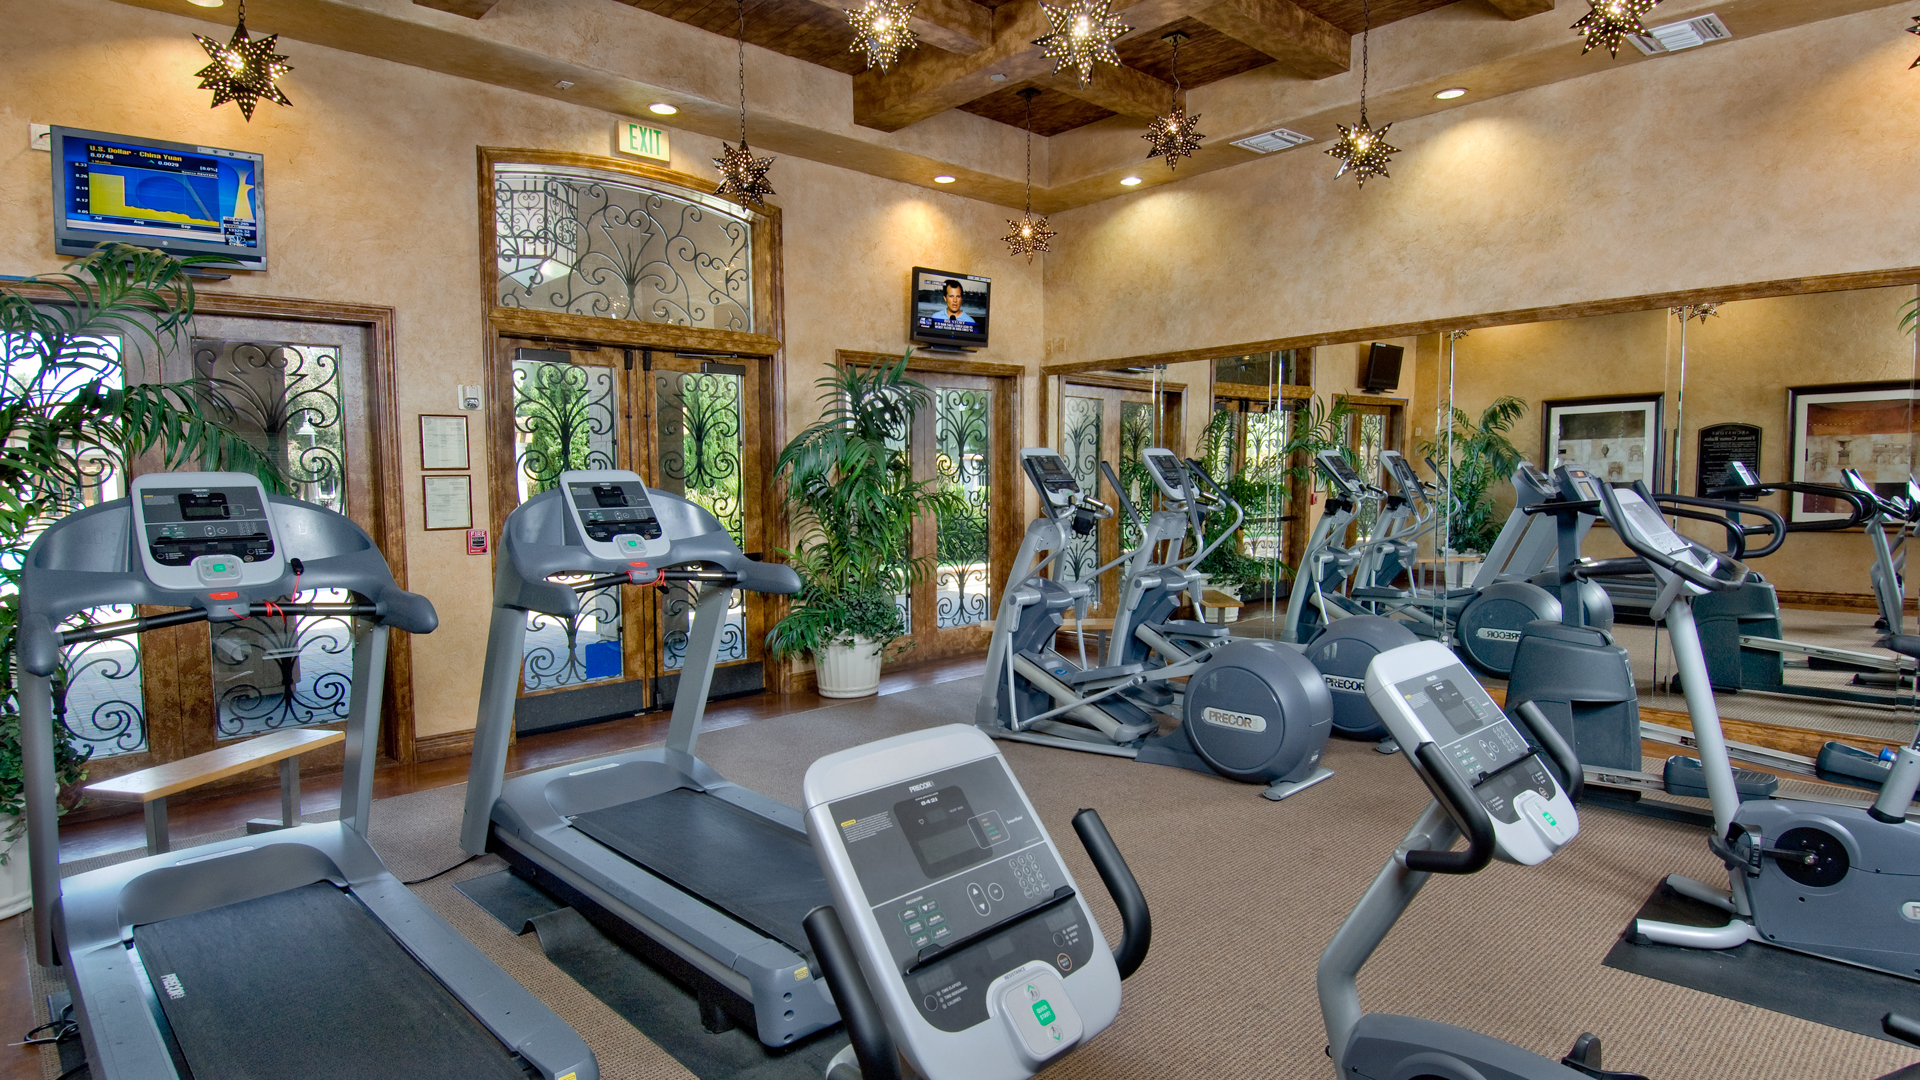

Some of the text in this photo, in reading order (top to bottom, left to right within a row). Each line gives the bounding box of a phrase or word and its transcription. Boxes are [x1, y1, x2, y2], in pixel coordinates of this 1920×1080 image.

[629, 123, 661, 155] EXIT
[90, 145, 106, 153] U.S.
[108, 147, 132, 155] Dollar
[139, 151, 162, 159] China
[163, 154, 183, 162] Yuan
[1325, 677, 1364, 690] PRECOR
[1208, 710, 1253, 728] PRECOR
[908, 781, 932, 793] PRECOR
